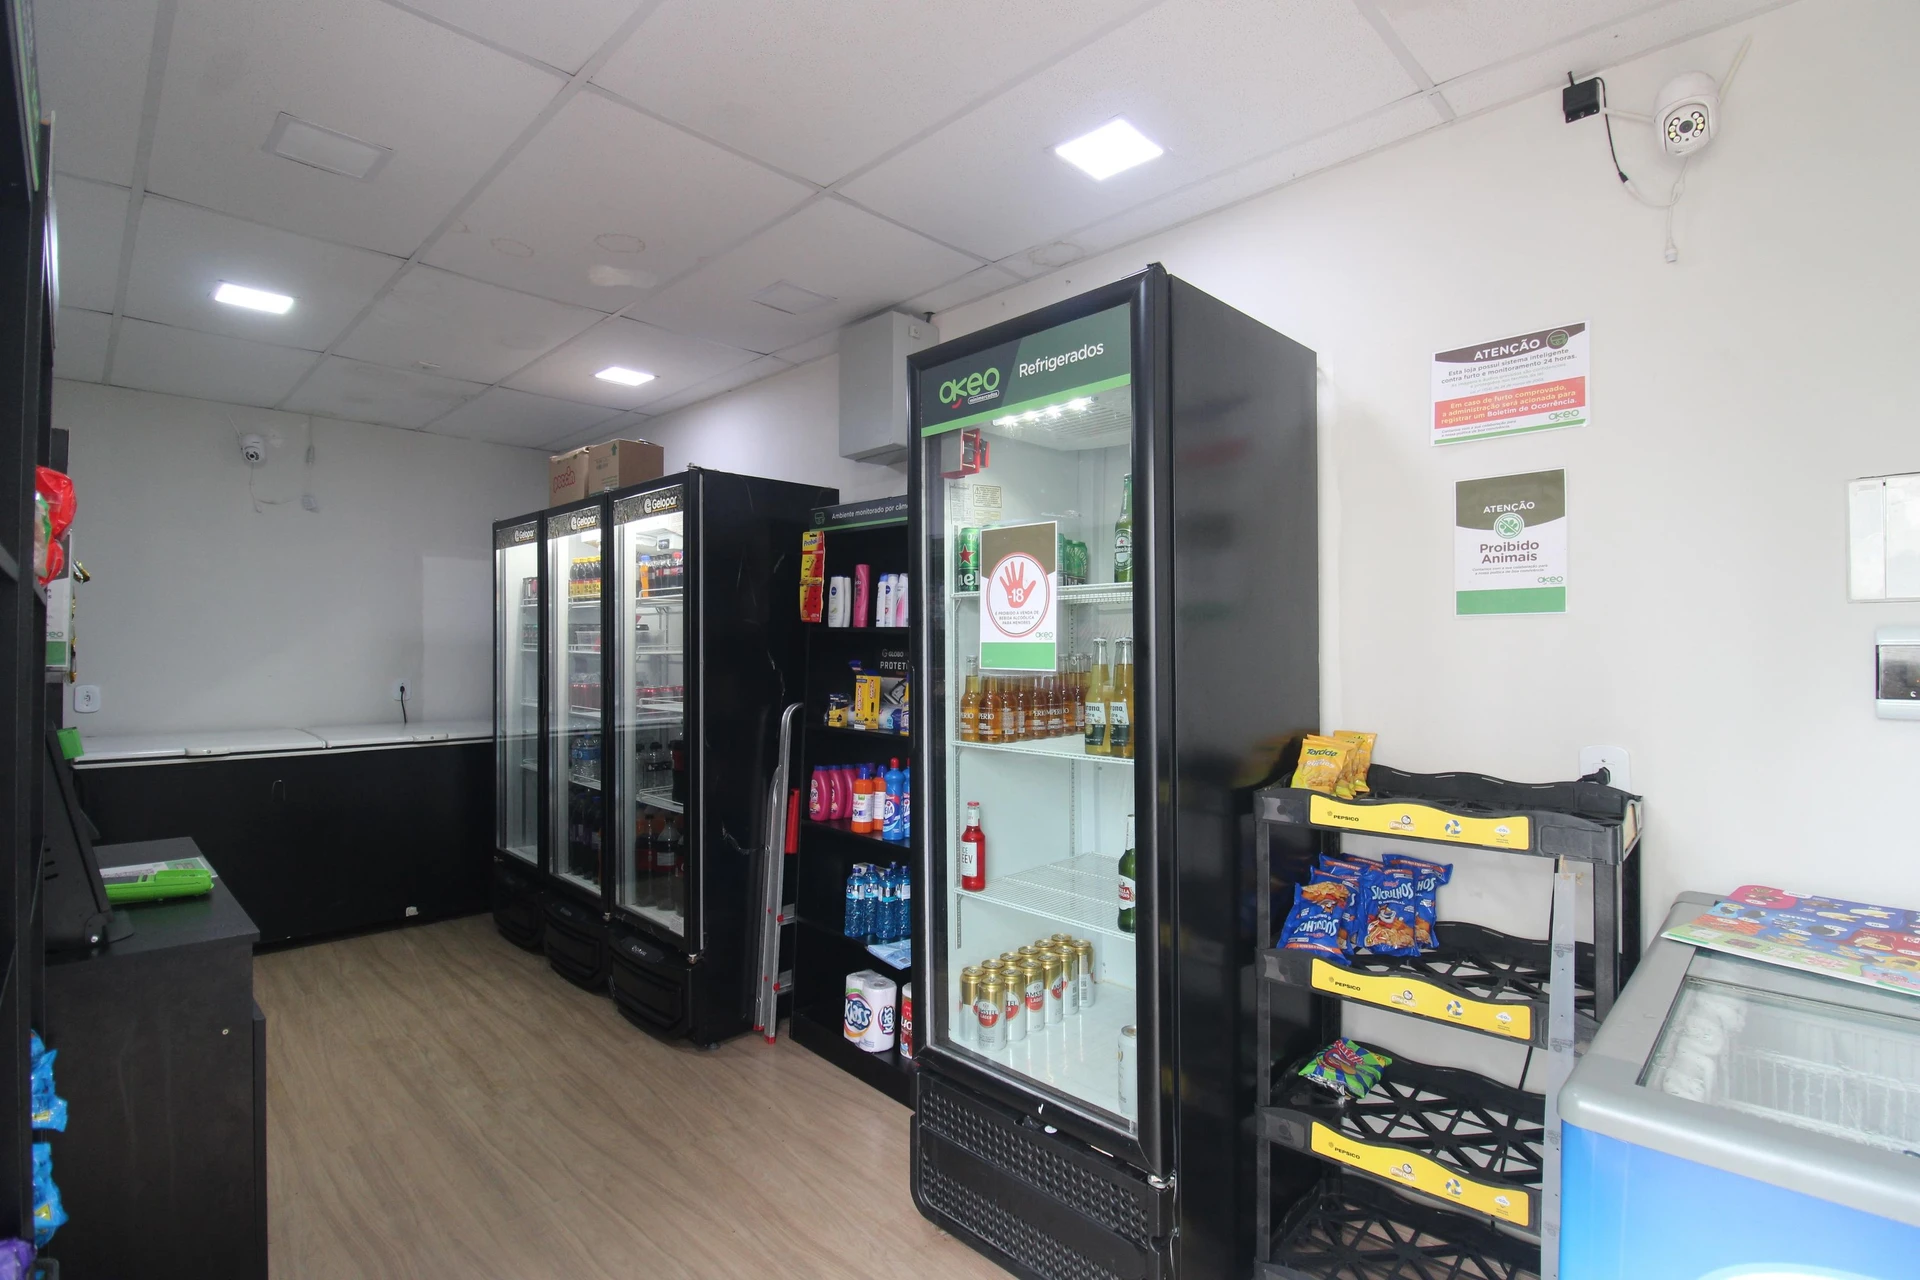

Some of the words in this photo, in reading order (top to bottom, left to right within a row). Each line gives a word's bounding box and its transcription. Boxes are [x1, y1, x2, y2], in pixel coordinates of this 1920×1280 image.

[1474, 338, 1541, 361] ATENÇÃO
[1019, 343, 1104, 378] Refrigerados
[1448, 369, 1463, 377] Esta
[1464, 367, 1477, 375] loja
[1478, 363, 1500, 372] possui
[1501, 357, 1528, 366] sistema
[1530, 349, 1569, 360] inteligente
[1441, 376, 1463, 384] contra
[1464, 372, 1481, 380] furto
[1488, 360, 1542, 375] monitoramento
[1554, 354, 1577, 363] horas.
[1448, 403, 1500, 416] administração
[1502, 400, 1518, 408] será
[1520, 394, 1556, 405] acionada
[1557, 390, 1576, 399] para
[1464, 399, 1481, 407] caso
[1515, 385, 1567, 398] comprovado,
[1441, 415, 1472, 425] registrar
[1487, 407, 1517, 417] Boletim
[1531, 398, 1577, 410] Ocorrência.
[652, 496, 677, 510] Gelopar
[1483, 501, 1536, 514] ATENÇÃO
[832, 511, 855, 520] Ambiente
[855, 506, 884, 516] monitorado
[885, 505, 895, 513] por
[577, 515, 597, 527] Gelopar
[519, 530, 535, 539] Gelopar
[1480, 540, 1540, 554] Proibido
[1481, 551, 1538, 564] Animais
[880, 661, 908, 670] PROTET
[1333, 814, 1359, 822] PEPSICO
[1371, 882, 1414, 900] SUCRILHOS
[1335, 981, 1361, 991] PEPSICO
[1334, 1146, 1361, 1160] PEPSICO
